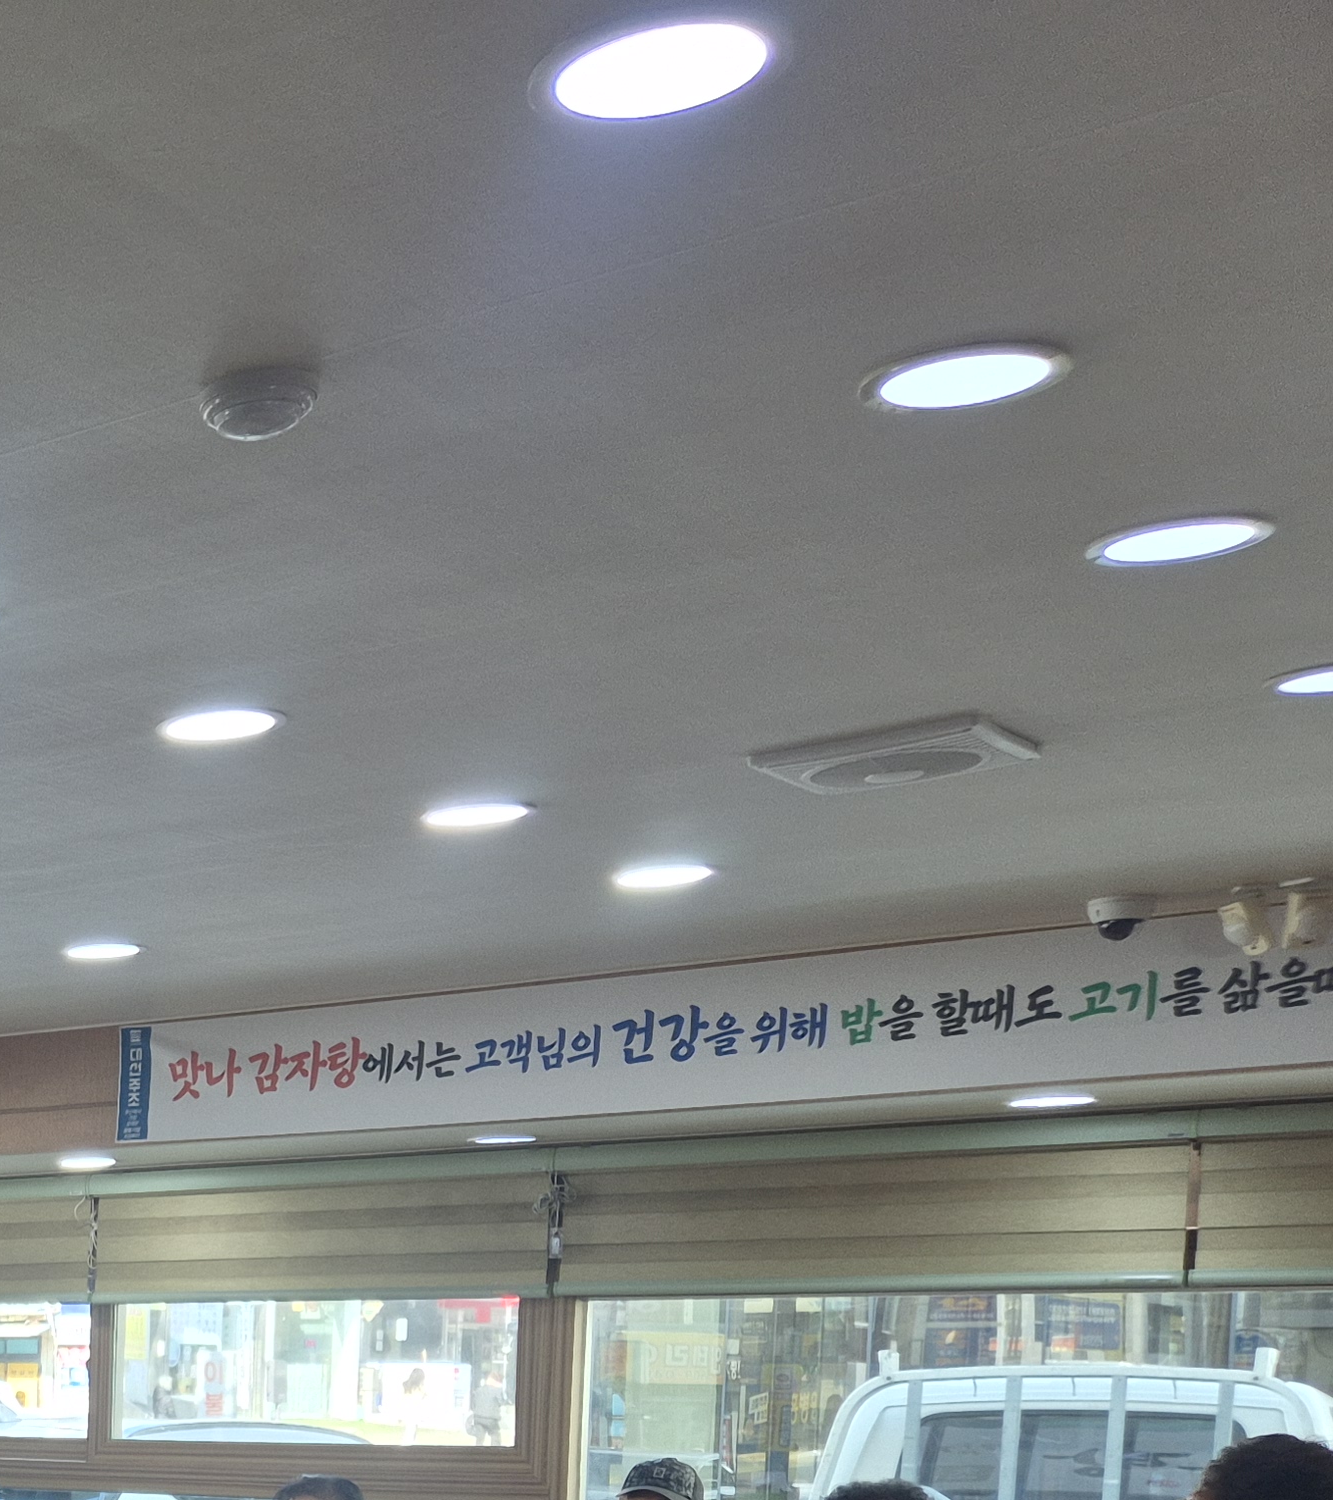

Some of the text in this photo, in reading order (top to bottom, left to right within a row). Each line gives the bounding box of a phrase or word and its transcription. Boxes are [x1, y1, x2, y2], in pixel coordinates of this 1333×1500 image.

[168, 1044, 242, 1102] 맛나
[247, 1036, 462, 1095] 감자탕에서는
[464, 1023, 602, 1074] 고객님의
[611, 1004, 745, 1065] 건강을
[750, 1002, 829, 1054] 위해
[840, 993, 924, 1046] 밥을
[931, 983, 1063, 1037] 할때도
[1068, 966, 1212, 1022] 고기를
